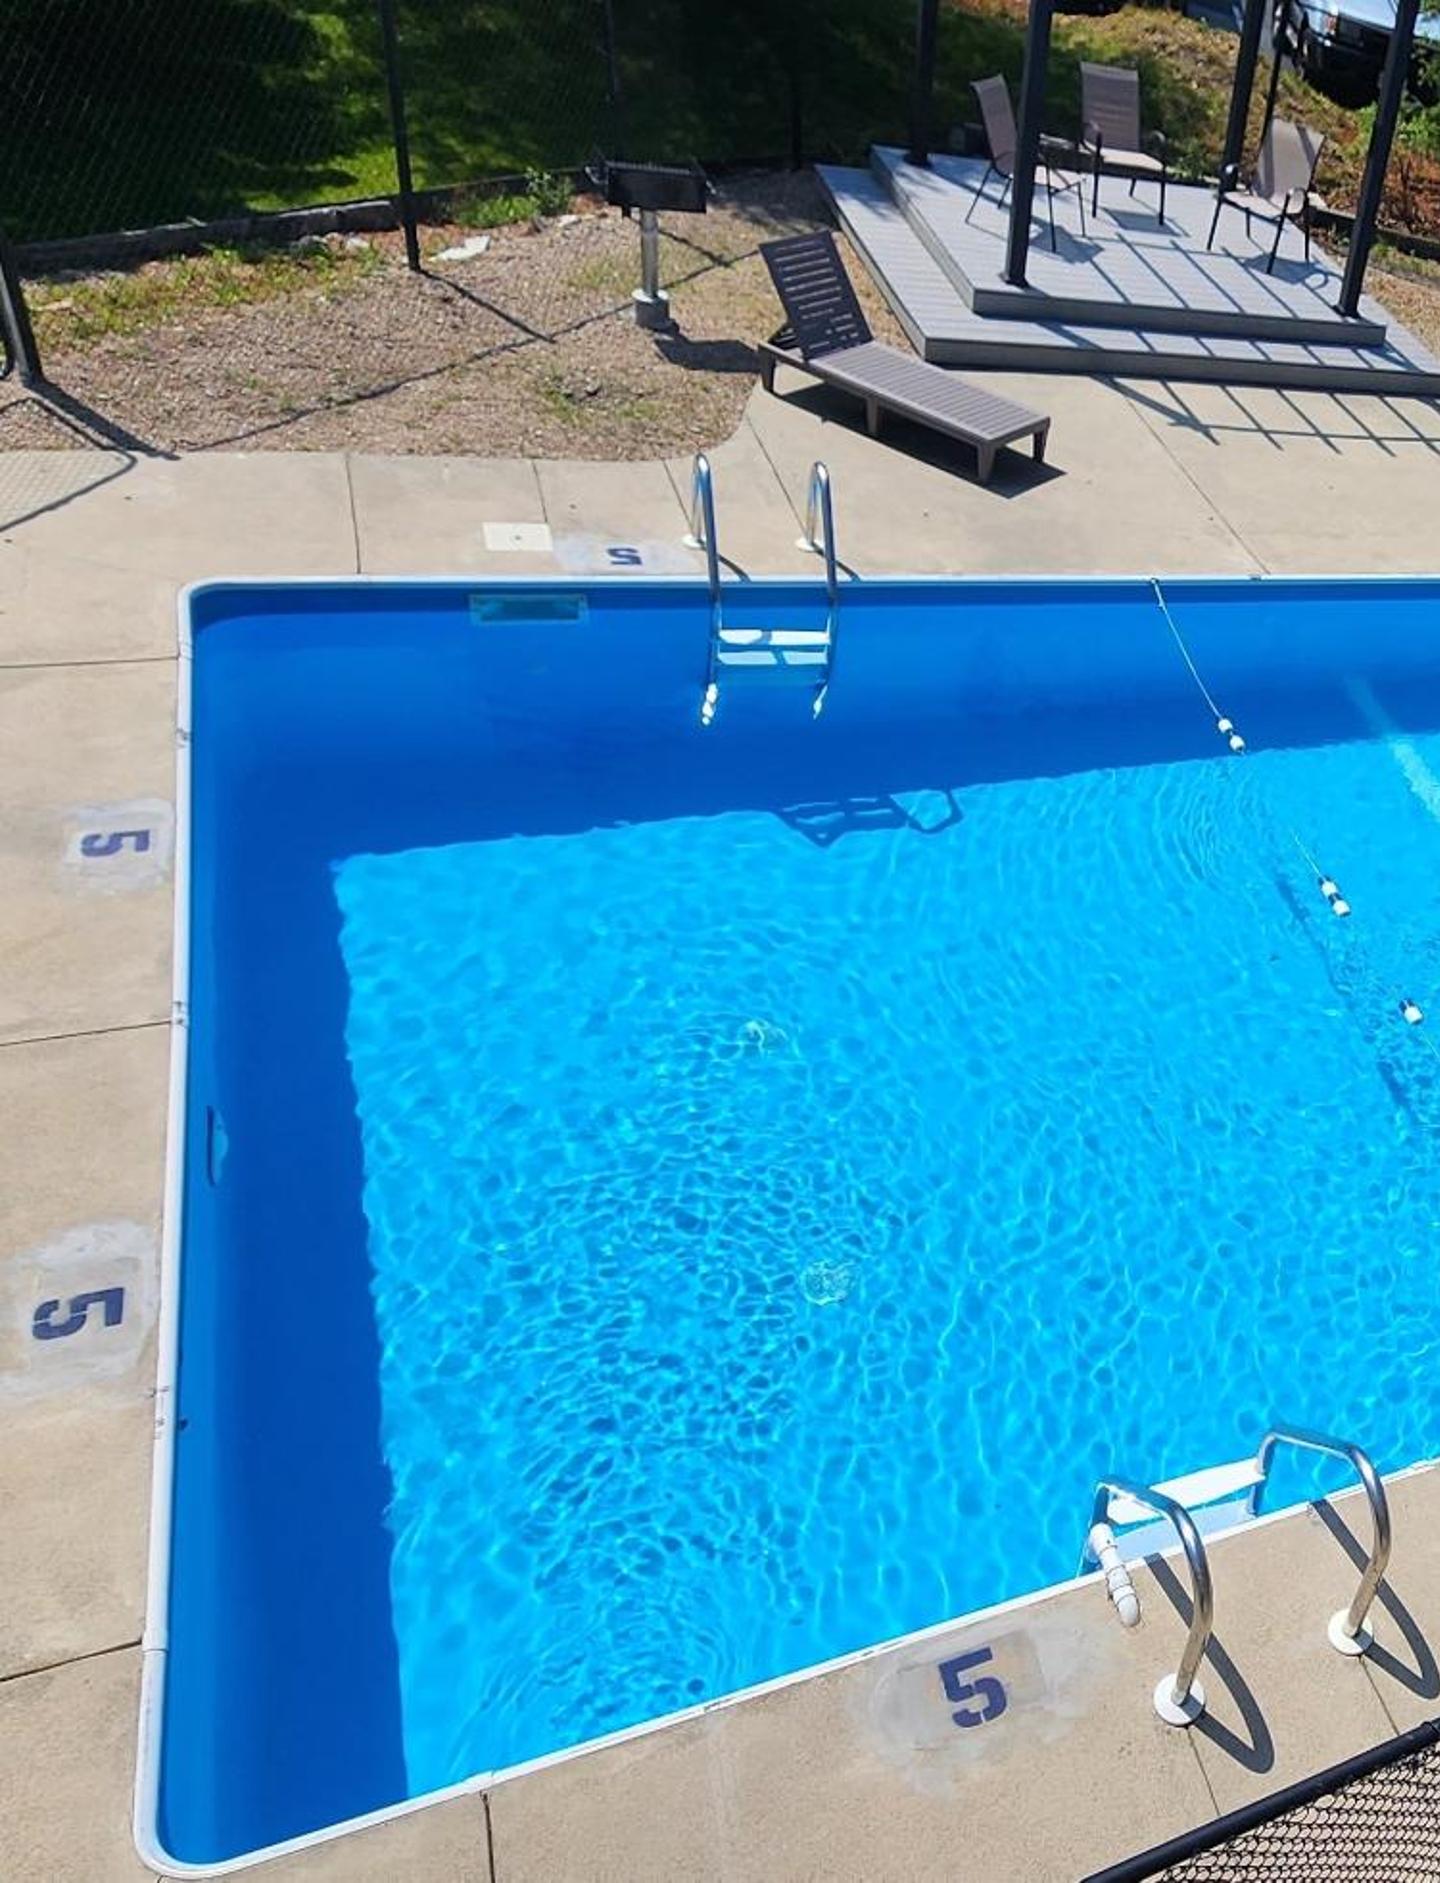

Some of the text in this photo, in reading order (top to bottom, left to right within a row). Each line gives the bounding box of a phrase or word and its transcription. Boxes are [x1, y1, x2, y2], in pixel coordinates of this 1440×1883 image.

[81, 829, 150, 858] 5
[32, 1286, 125, 1340] 5
[938, 1647, 1007, 1728] 5
